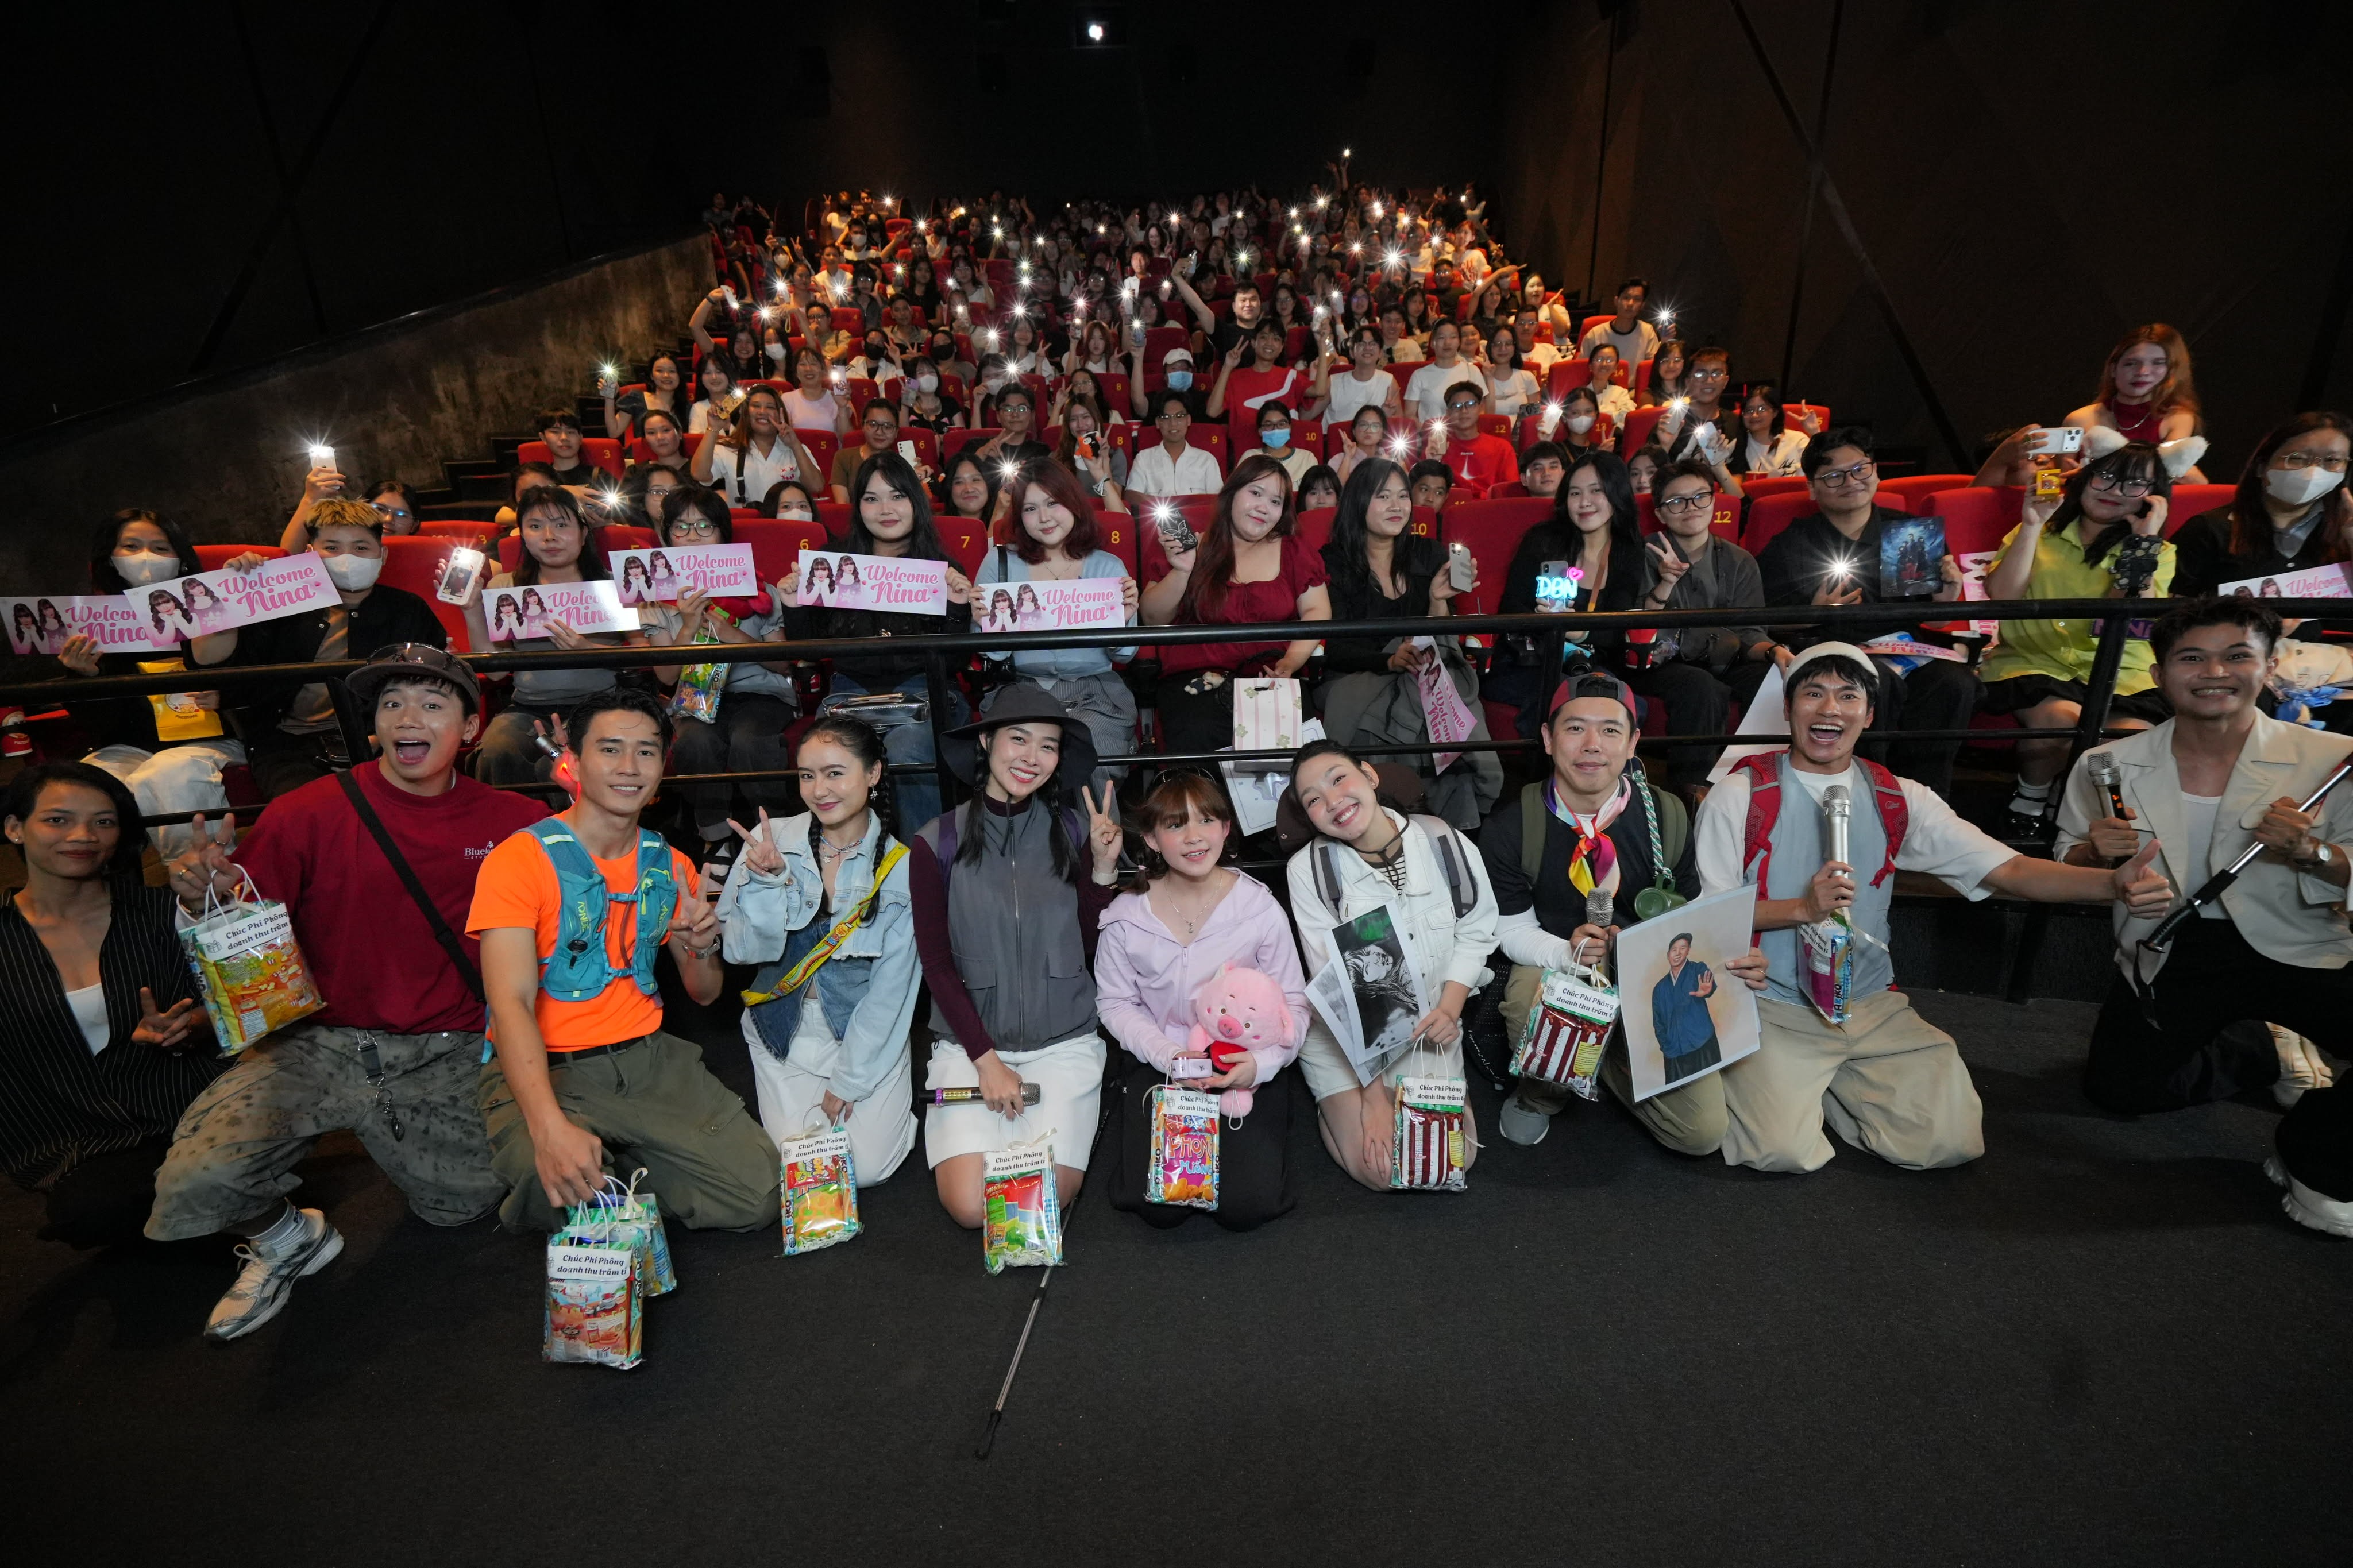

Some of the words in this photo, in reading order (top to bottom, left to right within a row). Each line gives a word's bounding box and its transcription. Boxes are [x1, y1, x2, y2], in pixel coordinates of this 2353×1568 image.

[1495, 425, 1506, 434] 12
[1117, 437, 1123, 445] 8
[1212, 435, 1218, 445] 9
[1306, 432, 1317, 441] 10
[820, 441, 827, 449] 5
[919, 441, 925, 449] 6
[604, 450, 610, 459] 3
[1714, 511, 1731, 523] 12
[1411, 523, 1427, 536] 10
[479, 534, 487, 546] 3
[961, 536, 970, 549] 7
[1111, 531, 1120, 544] 8
[799, 539, 809, 550] 6
[675, 553, 745, 570] Welcome
[217, 565, 317, 594] Welcome
[863, 564, 938, 584] Welcome
[687, 570, 742, 592] Nina
[870, 583, 931, 604] Nina
[1042, 589, 1116, 605] Welcome
[236, 584, 316, 617] Nina
[65, 605, 136, 623] Welco
[1050, 605, 1109, 627] Nina
[226, 926, 247, 939] Chúc
[248, 919, 264, 931] Phí
[264, 912, 288, 925] Phông
[228, 936, 254, 950] doanh
[256, 929, 269, 940] thu
[271, 922, 289, 934] trăm
[1563, 988, 1579, 998] Chúc
[1580, 993, 1592, 1002] Phí
[1593, 997, 1614, 1010] Phông
[1556, 997, 1578, 1007] doanh
[1579, 1003, 1590, 1011] thu
[1591, 1007, 1609, 1017] trăm
[1445, 1086, 1463, 1094] Phông
[796, 1150, 816, 1158] doanh
[1023, 1151, 1043, 1160] Phông
[562, 1254, 583, 1262] Chúc
[584, 1256, 598, 1264] Phí
[598, 1257, 625, 1266] Phông
[599, 1267, 620, 1275] trăm
